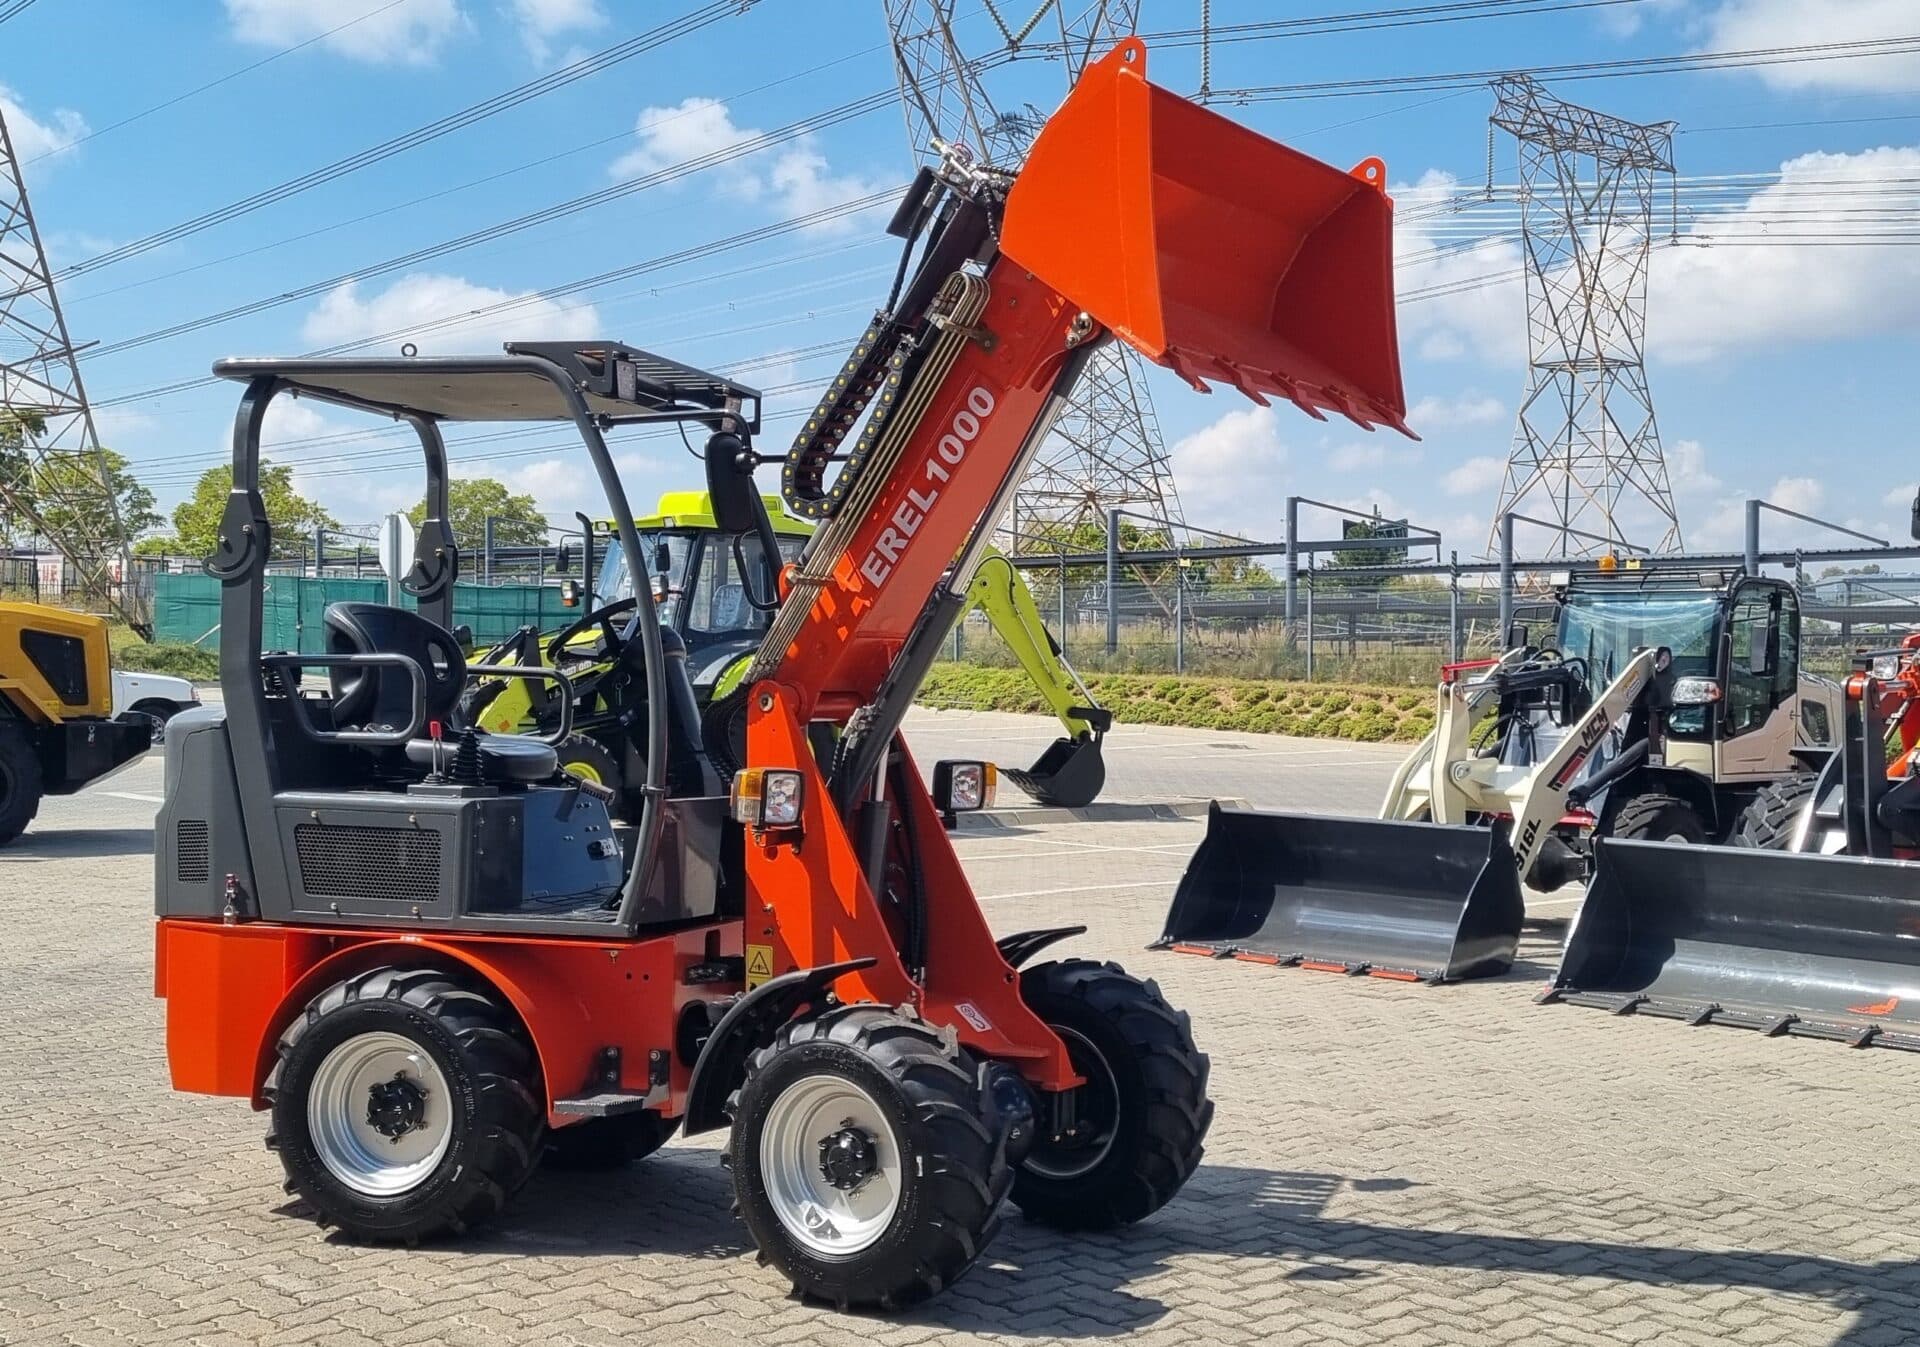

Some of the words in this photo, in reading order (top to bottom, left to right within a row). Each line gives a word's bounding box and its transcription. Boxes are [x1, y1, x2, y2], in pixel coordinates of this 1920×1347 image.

[859, 486, 939, 590] EREL
[925, 385, 996, 485] 1000
[1581, 706, 1610, 747] MCM
[1514, 818, 1542, 872] 916L
